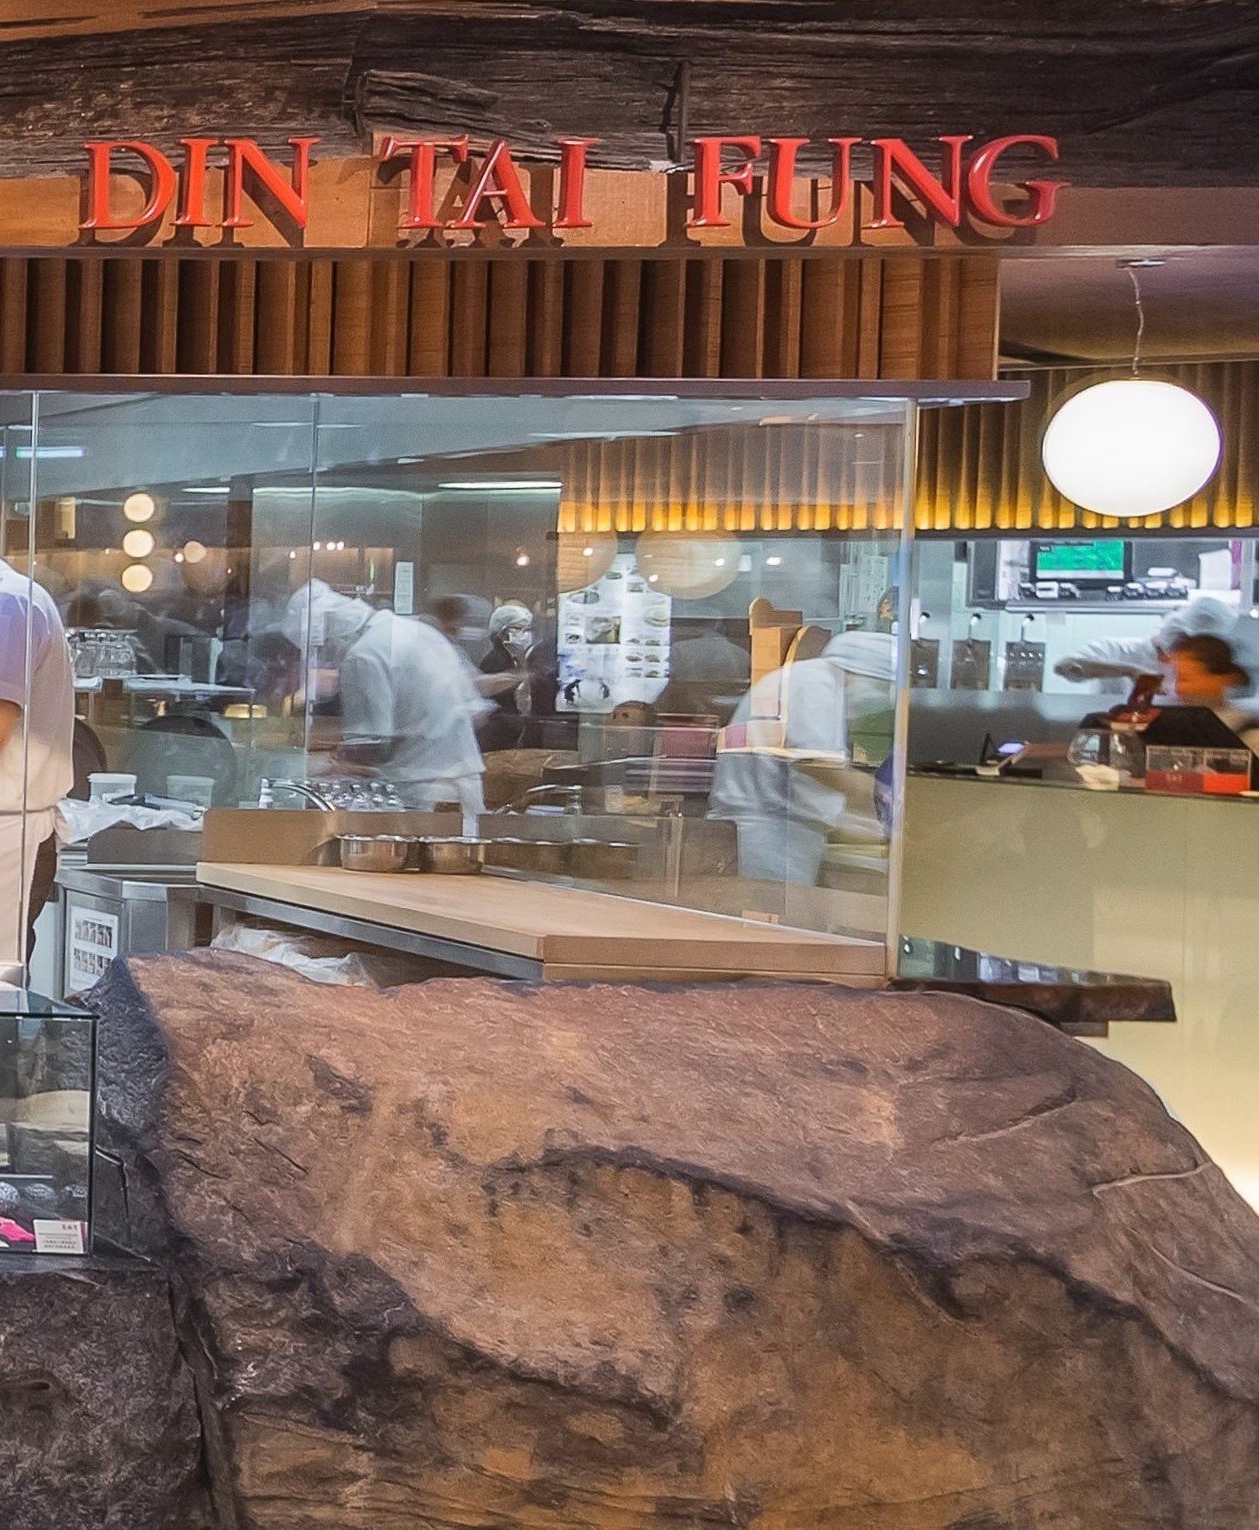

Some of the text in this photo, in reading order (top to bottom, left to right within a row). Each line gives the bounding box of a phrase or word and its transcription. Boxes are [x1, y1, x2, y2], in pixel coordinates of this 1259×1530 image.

[78, 134, 1072, 230] DIN TAI FUNG
